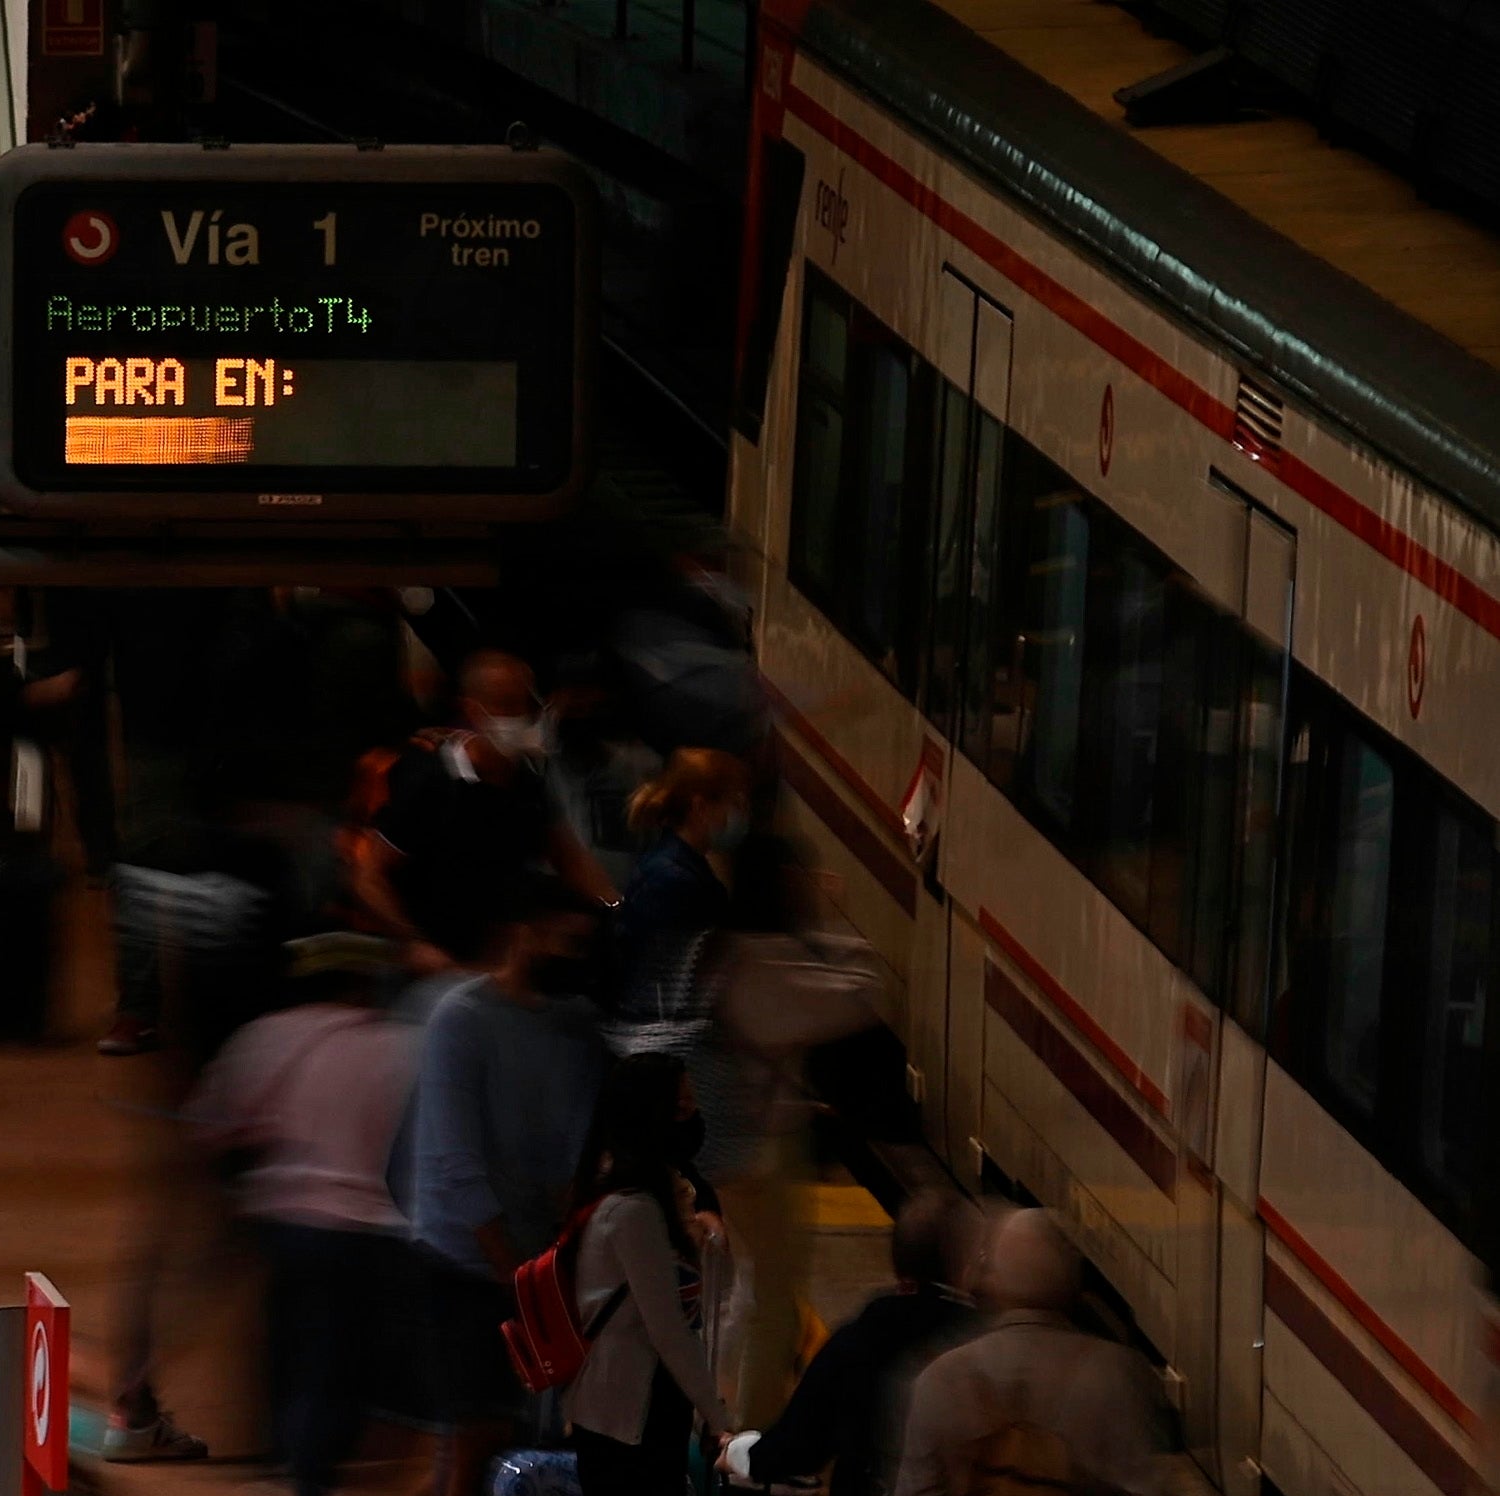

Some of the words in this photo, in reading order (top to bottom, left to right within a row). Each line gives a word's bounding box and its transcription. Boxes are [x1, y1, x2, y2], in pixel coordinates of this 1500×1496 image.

[160, 211, 260, 266] Vía
[313, 211, 338, 266] 1
[419, 213, 542, 239] Próximo
[450, 242, 510, 267] tren
[46, 296, 373, 333] AeropuertoT4
[65, 357, 186, 405] PARA
[215, 358, 296, 406] EN:
